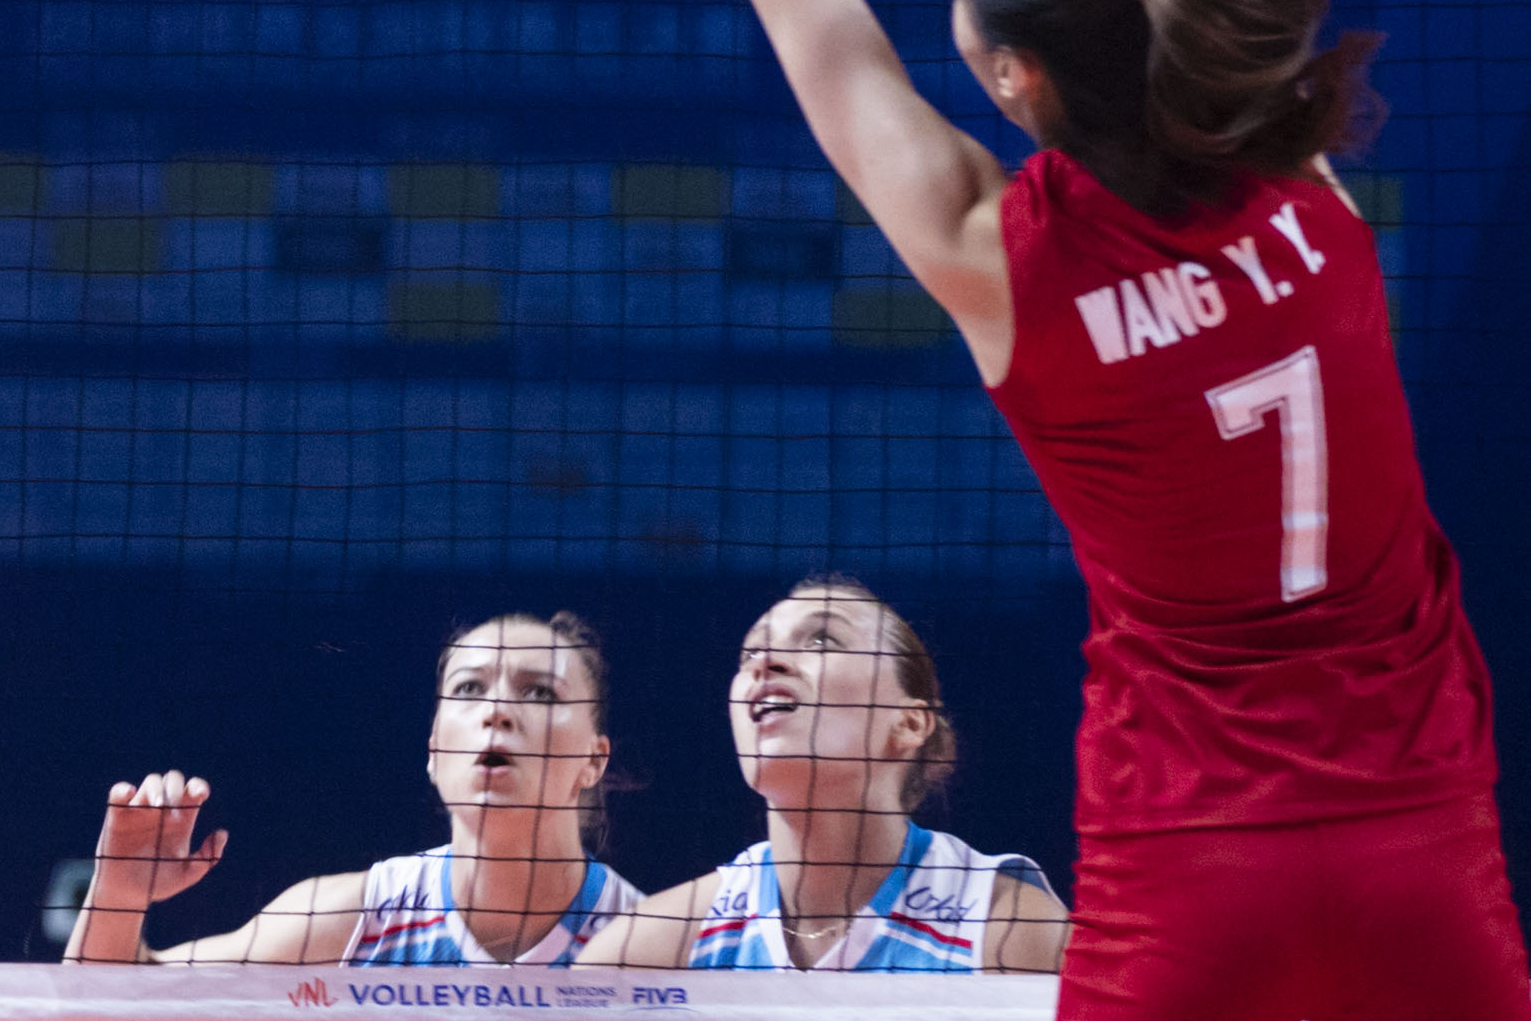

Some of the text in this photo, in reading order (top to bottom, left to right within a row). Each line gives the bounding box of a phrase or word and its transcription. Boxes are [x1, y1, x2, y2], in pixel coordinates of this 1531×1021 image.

[1074, 202, 1326, 366] WANG Y. Y.
[1204, 345, 1329, 603] 7
[349, 983, 551, 1008] VOLLEYBALL
[633, 986, 688, 1004] FIVB
